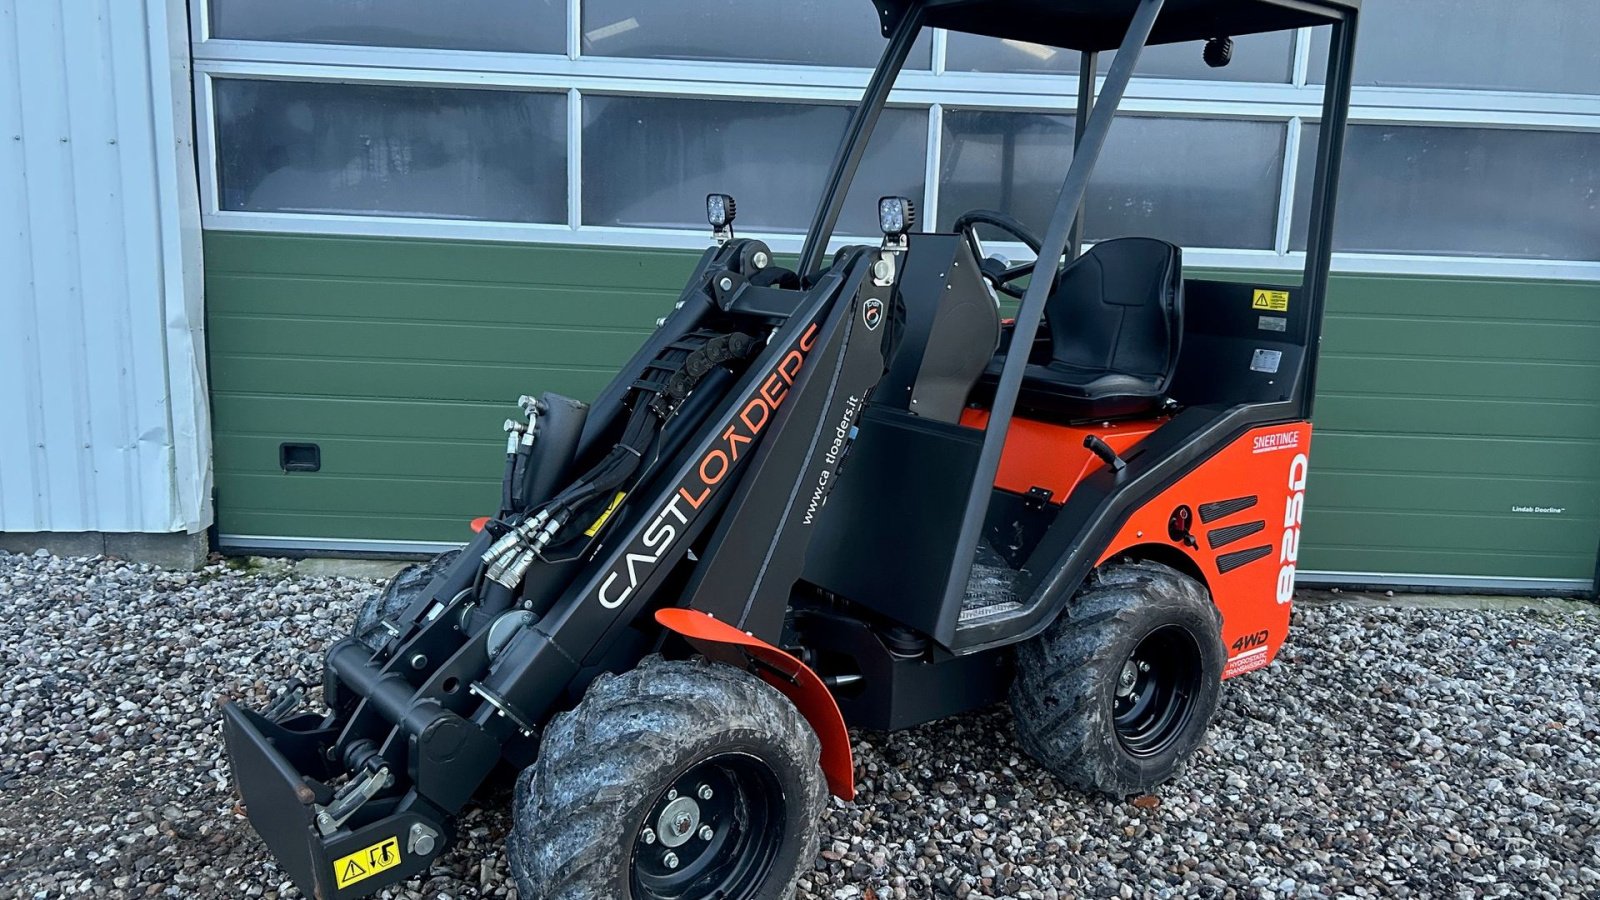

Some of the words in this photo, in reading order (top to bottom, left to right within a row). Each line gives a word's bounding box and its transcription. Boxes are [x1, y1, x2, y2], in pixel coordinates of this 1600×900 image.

[1253, 430, 1299, 449] SNERTINGE
[1276, 453, 1308, 605] 825D
[1231, 629, 1269, 651] 4WD
